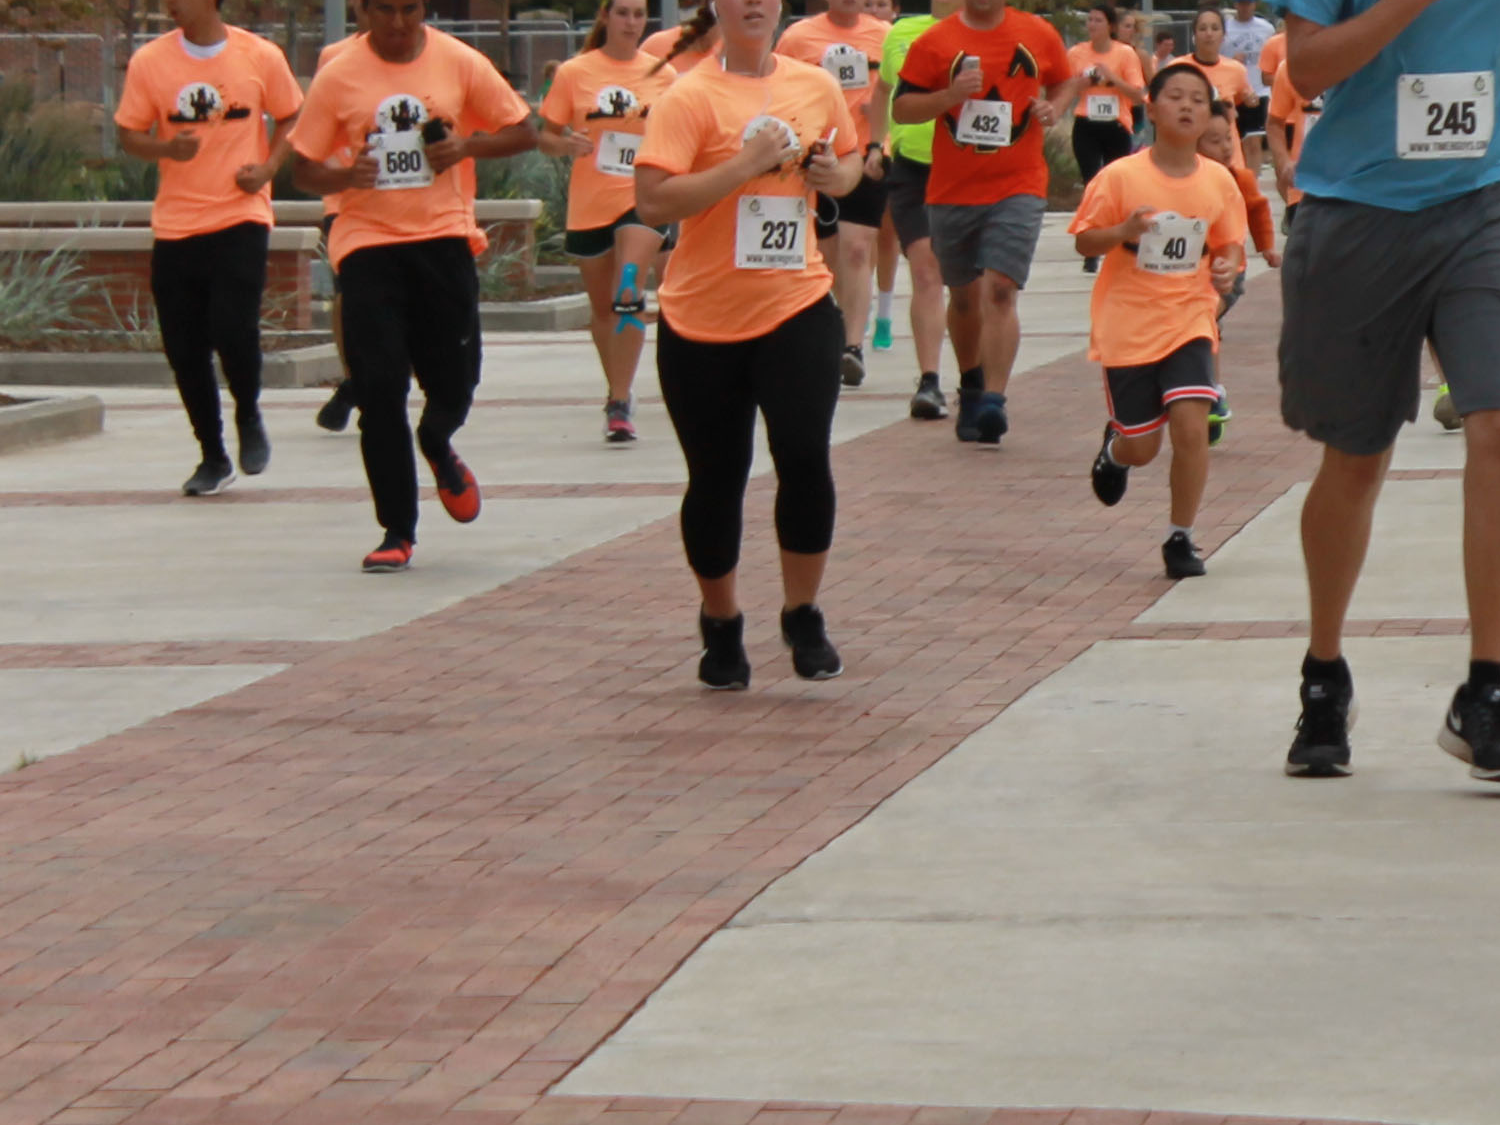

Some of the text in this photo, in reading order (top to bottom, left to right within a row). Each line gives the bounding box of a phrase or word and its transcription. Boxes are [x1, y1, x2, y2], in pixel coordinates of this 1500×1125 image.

[971, 115, 1000, 134] 432
[1426, 100, 1477, 136] 245
[386, 149, 422, 174] 580
[760, 220, 799, 251] 237
[1162, 237, 1187, 260] 40
